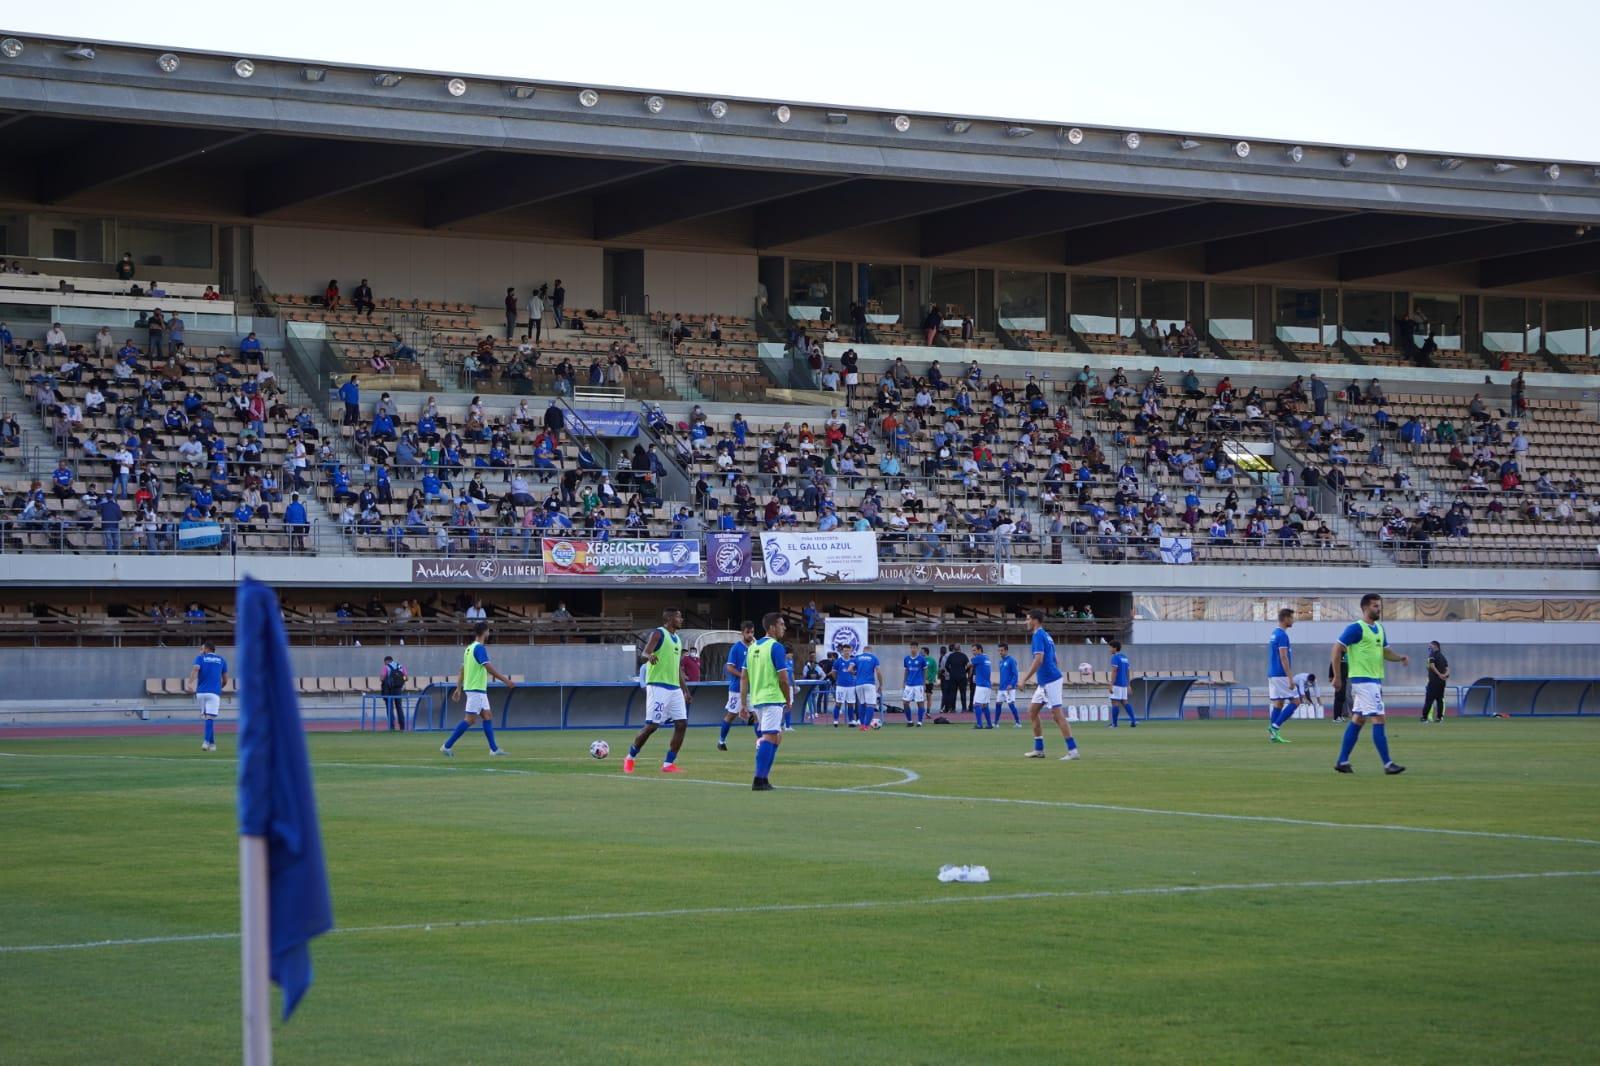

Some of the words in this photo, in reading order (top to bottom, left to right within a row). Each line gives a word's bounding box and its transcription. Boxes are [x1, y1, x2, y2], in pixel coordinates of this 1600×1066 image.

[800, 543, 828, 551] GALLO
[830, 542, 852, 550] AZUL
[585, 556, 606, 567] POR
[608, 556, 621, 566] EL
[621, 556, 660, 567] MUNDO
[502, 565, 541, 576] ALIMENT
[879, 568, 905, 579] ALIDA
[654, 701, 665, 712] 20
